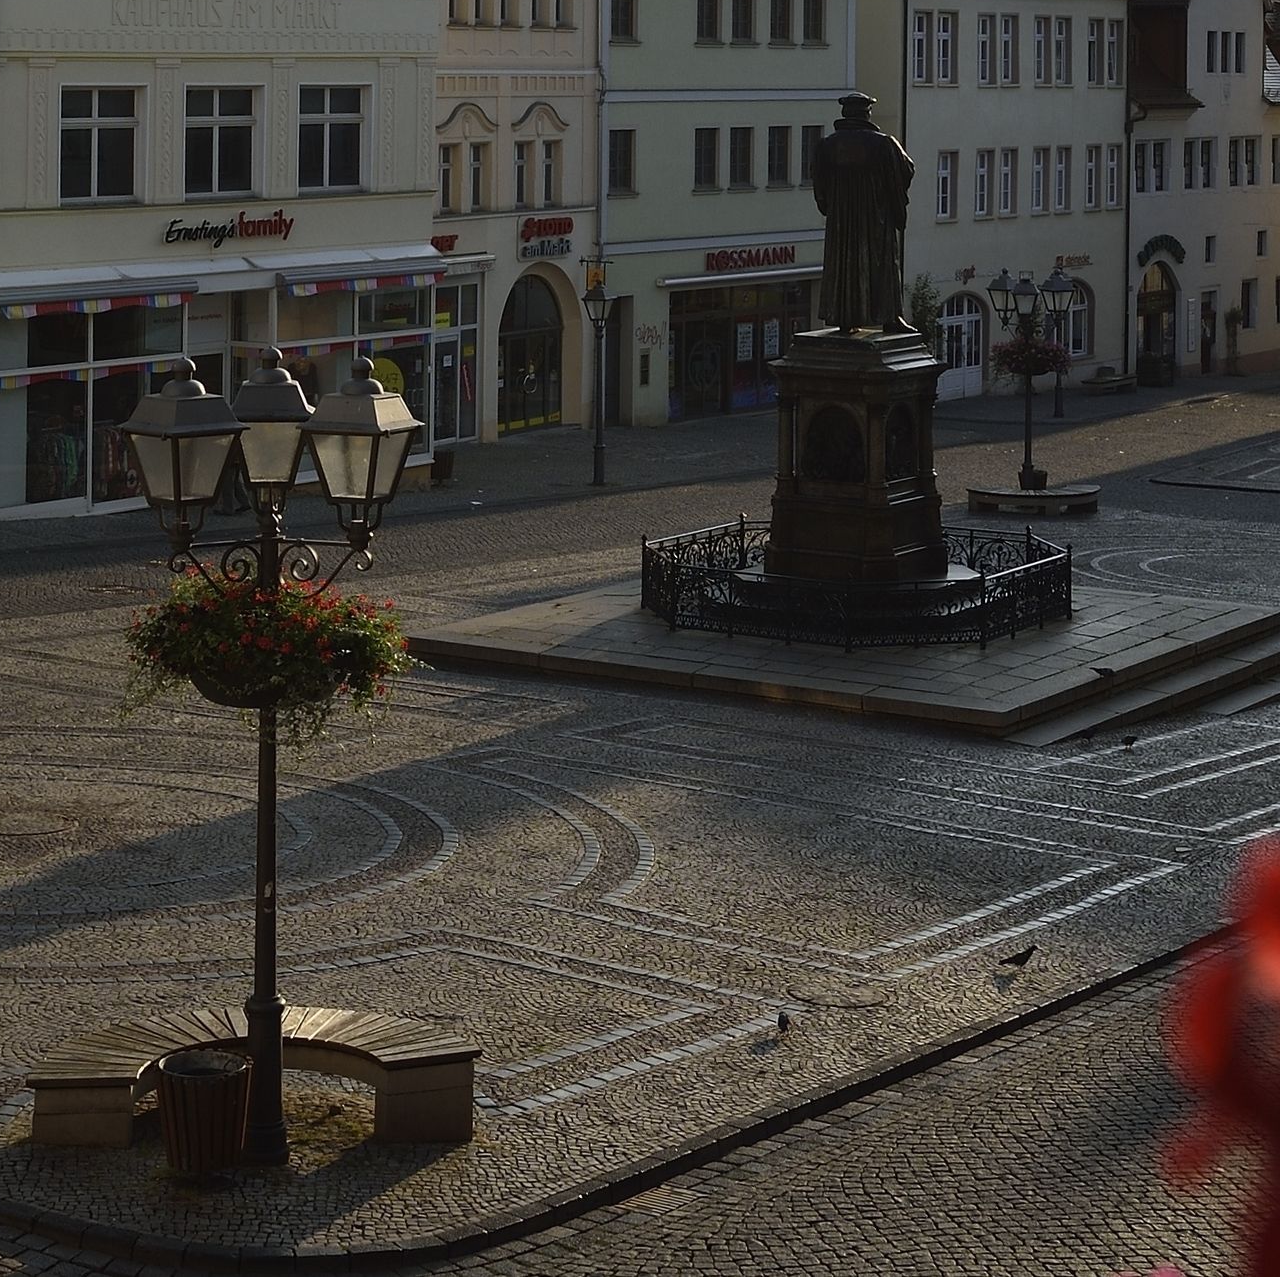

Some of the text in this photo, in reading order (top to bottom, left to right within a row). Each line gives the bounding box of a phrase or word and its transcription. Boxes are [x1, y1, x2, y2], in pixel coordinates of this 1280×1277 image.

[165, 209, 294, 248] Ernsting's family
[706, 245, 795, 271] ROSSMANN
